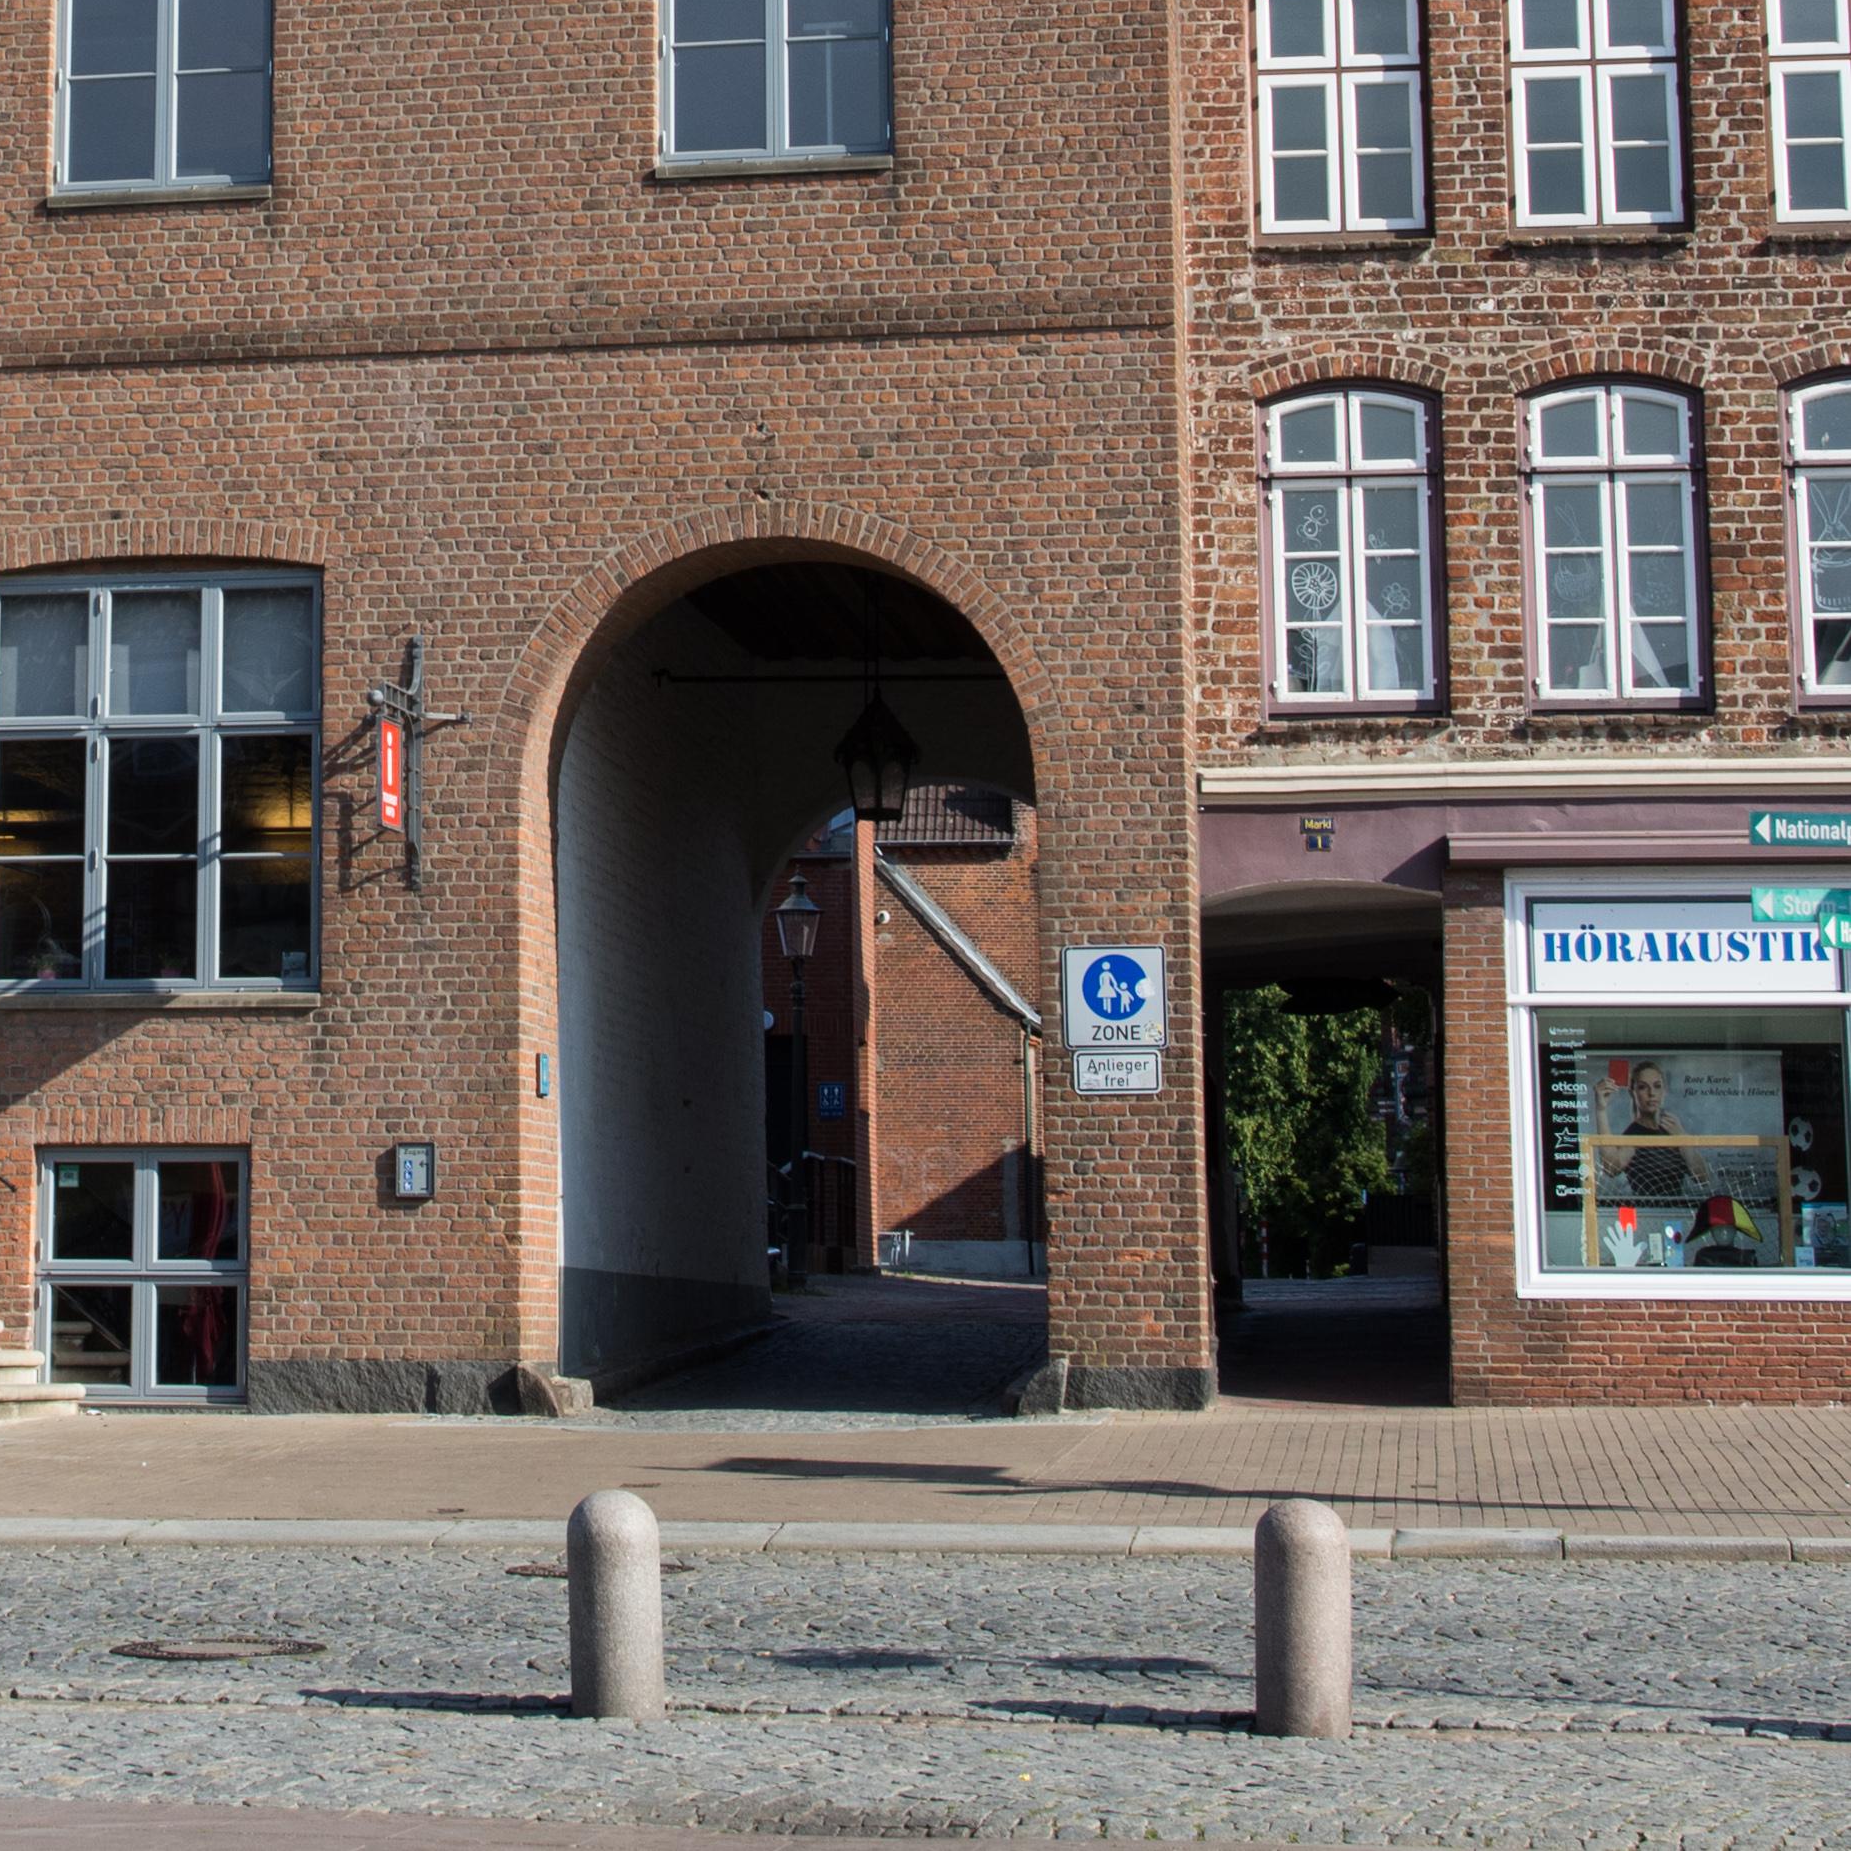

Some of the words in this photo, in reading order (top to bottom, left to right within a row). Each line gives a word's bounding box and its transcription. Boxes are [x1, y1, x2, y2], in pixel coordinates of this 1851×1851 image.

[1543, 924, 1830, 962] HÖRAKUSTIK
[1092, 1025, 1141, 1040] ZONE
[1087, 1058, 1149, 1074] Anlieger
[1105, 1074, 1129, 1087] frei
[1684, 1075, 1704, 1084] Rote
[1707, 1075, 1731, 1084] Karte
[1551, 1081, 1587, 1092] oticon
[1683, 1087, 1698, 1098] für
[1552, 1113, 1590, 1123] ReSound
